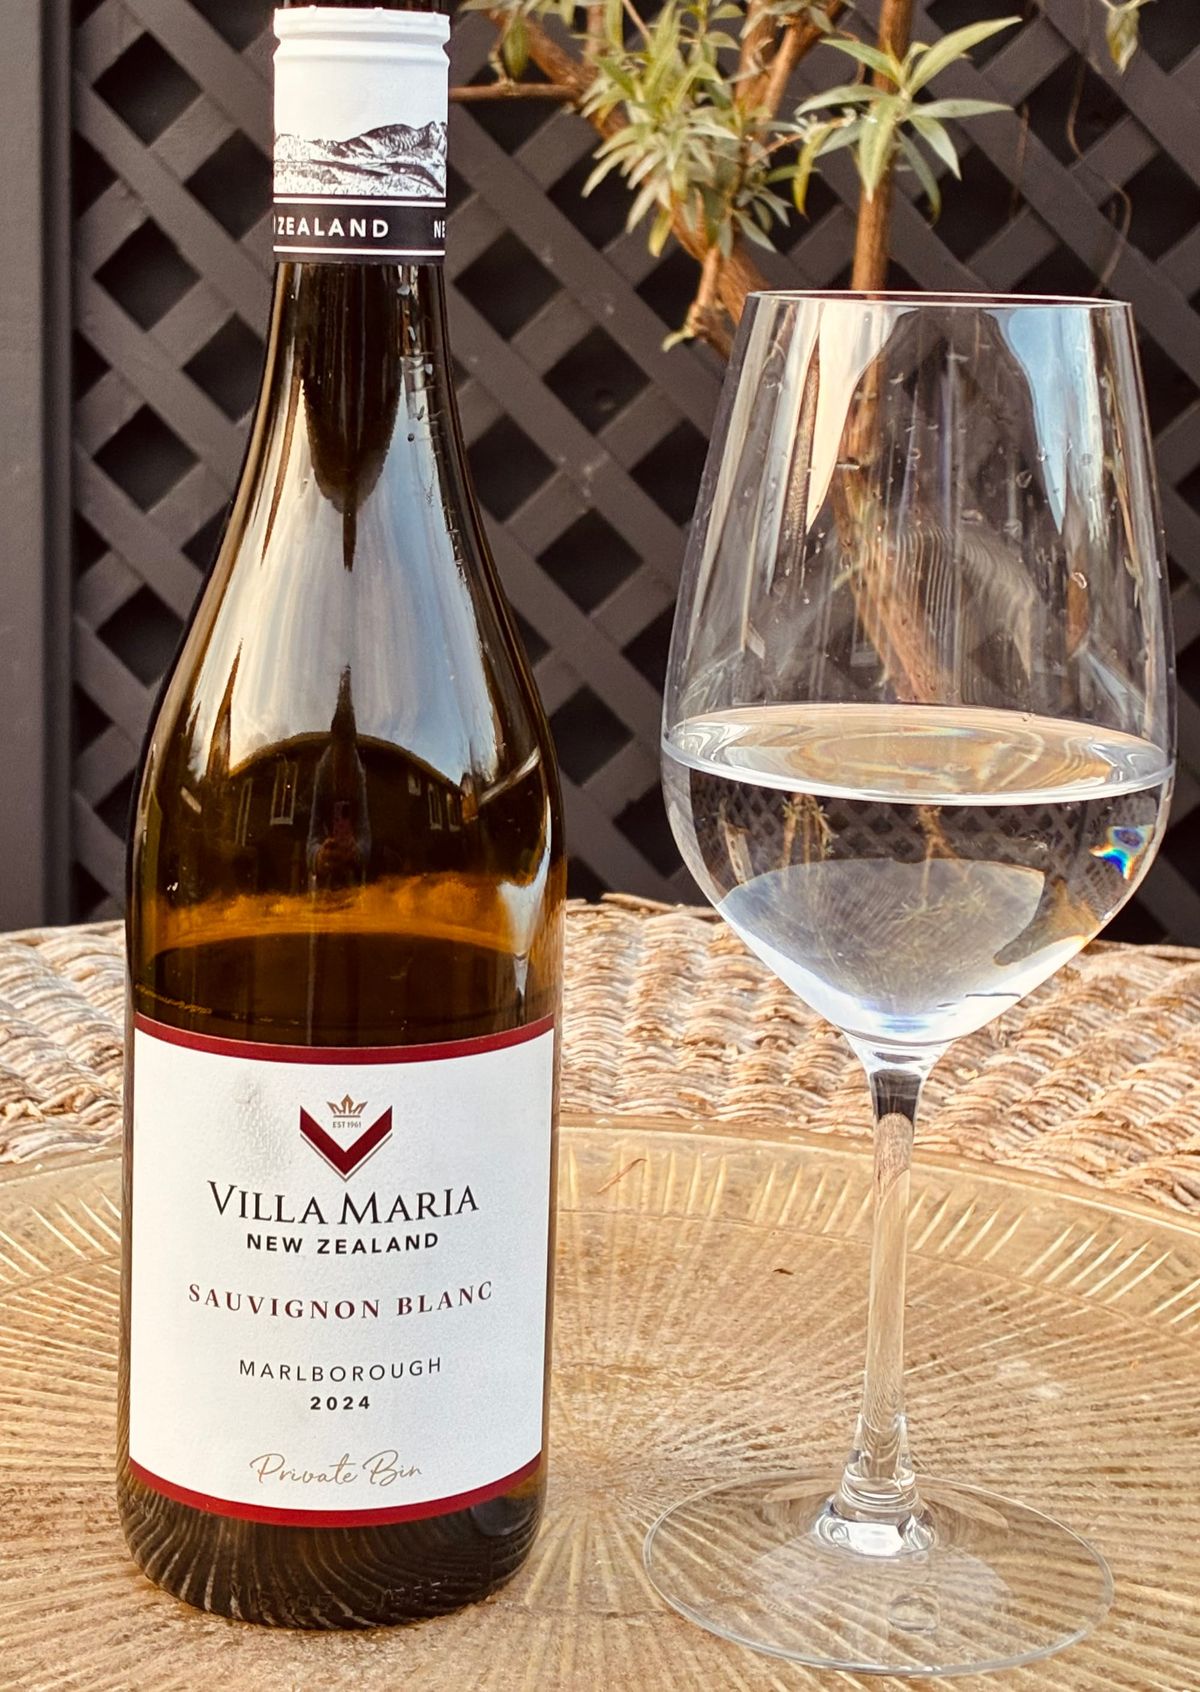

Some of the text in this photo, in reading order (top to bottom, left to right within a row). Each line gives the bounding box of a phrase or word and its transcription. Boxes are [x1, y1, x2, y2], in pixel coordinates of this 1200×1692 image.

[277, 216, 389, 238] ZEALAND
[332, 1121, 362, 1129] EST 1961
[247, 1232, 439, 1255] NEW ZEALAND
[189, 1280, 492, 1320] SAUVIGNON BLANC
[239, 1356, 441, 1383] MARLBOROUGH
[310, 1395, 371, 1411] 2024
[249, 1449, 423, 1487] Private Bin
